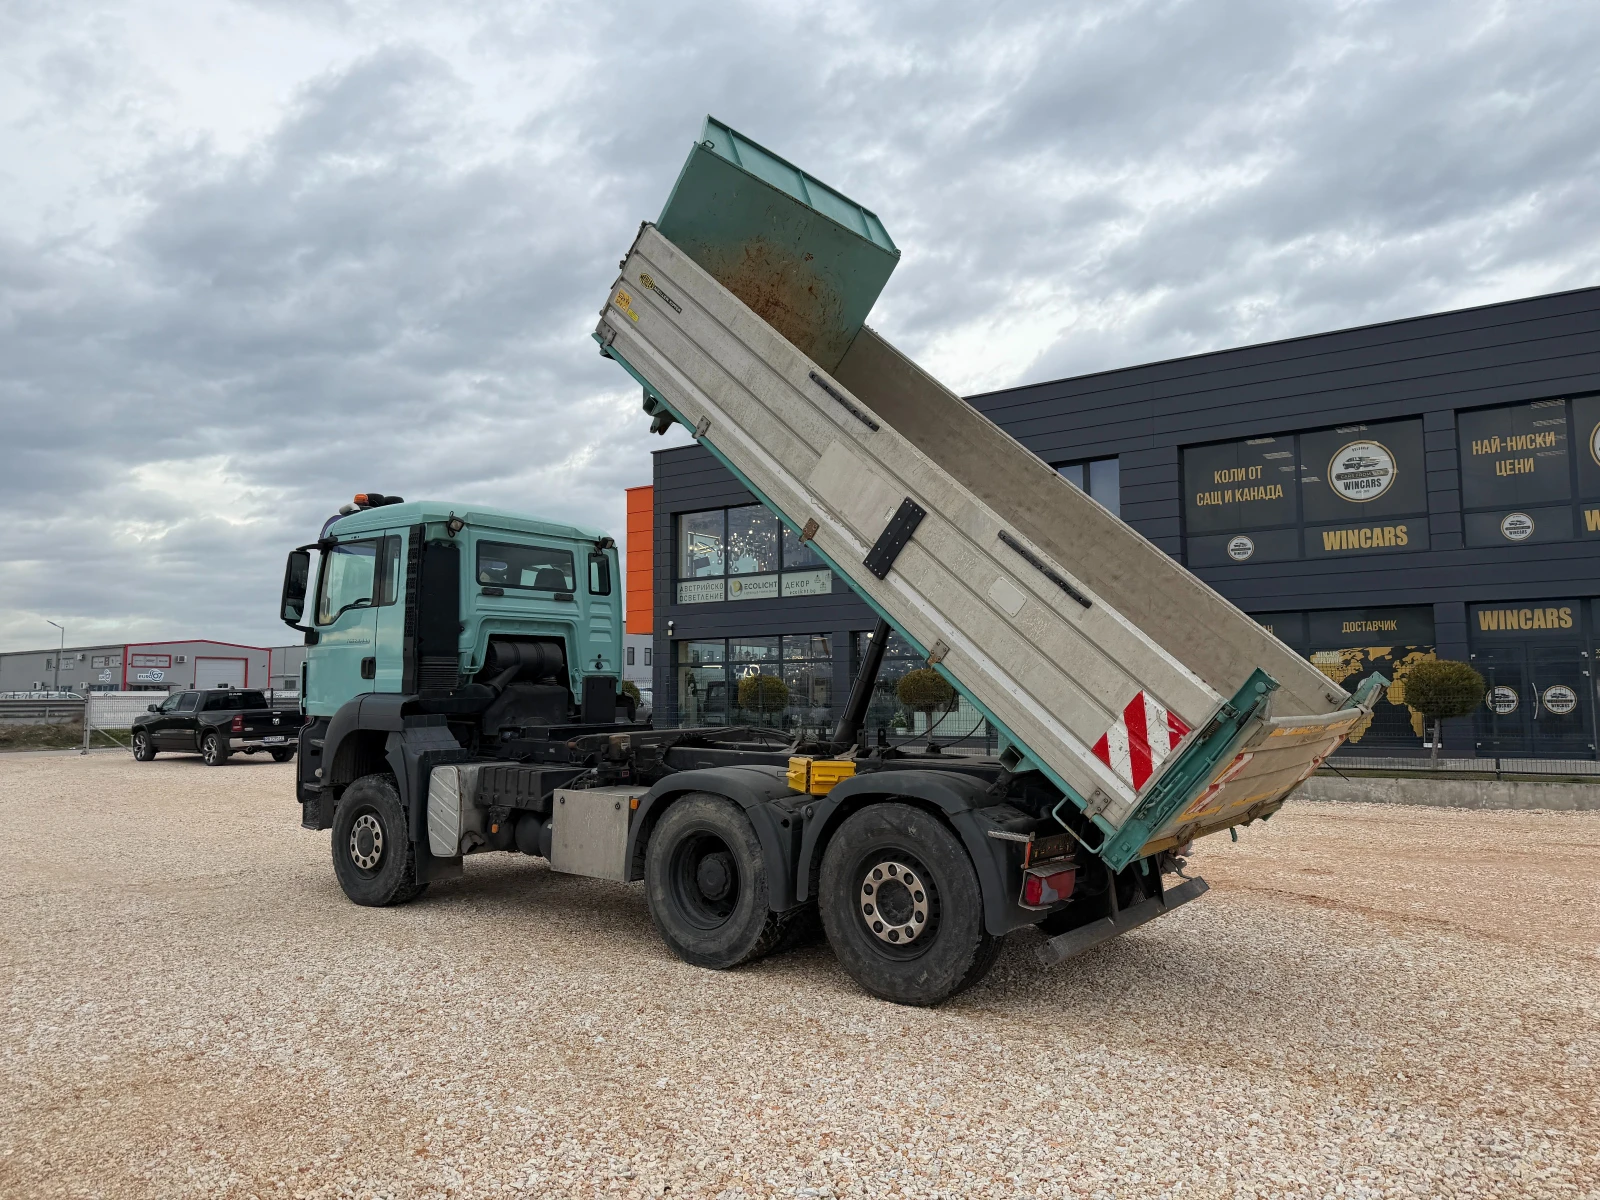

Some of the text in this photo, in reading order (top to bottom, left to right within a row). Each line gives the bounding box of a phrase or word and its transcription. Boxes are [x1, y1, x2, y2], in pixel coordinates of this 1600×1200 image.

[1472, 431, 1556, 455] НАЙ-НИСКИ
[1214, 465, 1262, 484] КОЛИ ОТ
[1495, 457, 1534, 477] ЦЕНИ
[1343, 478, 1382, 491] WINCARS
[1196, 484, 1283, 506] САЩ И КАНАДА
[1322, 525, 1408, 551] WINCARS
[679, 583, 723, 592] АВСТРИЙСКО
[744, 581, 777, 590] ECOLICHT
[785, 580, 810, 589] ДЕКОР
[679, 592, 723, 601] ОСВЕТЛЕНИЕ
[1341, 620, 1397, 633] ДОСТАВЧИК
[1478, 607, 1573, 630] WINCARS
